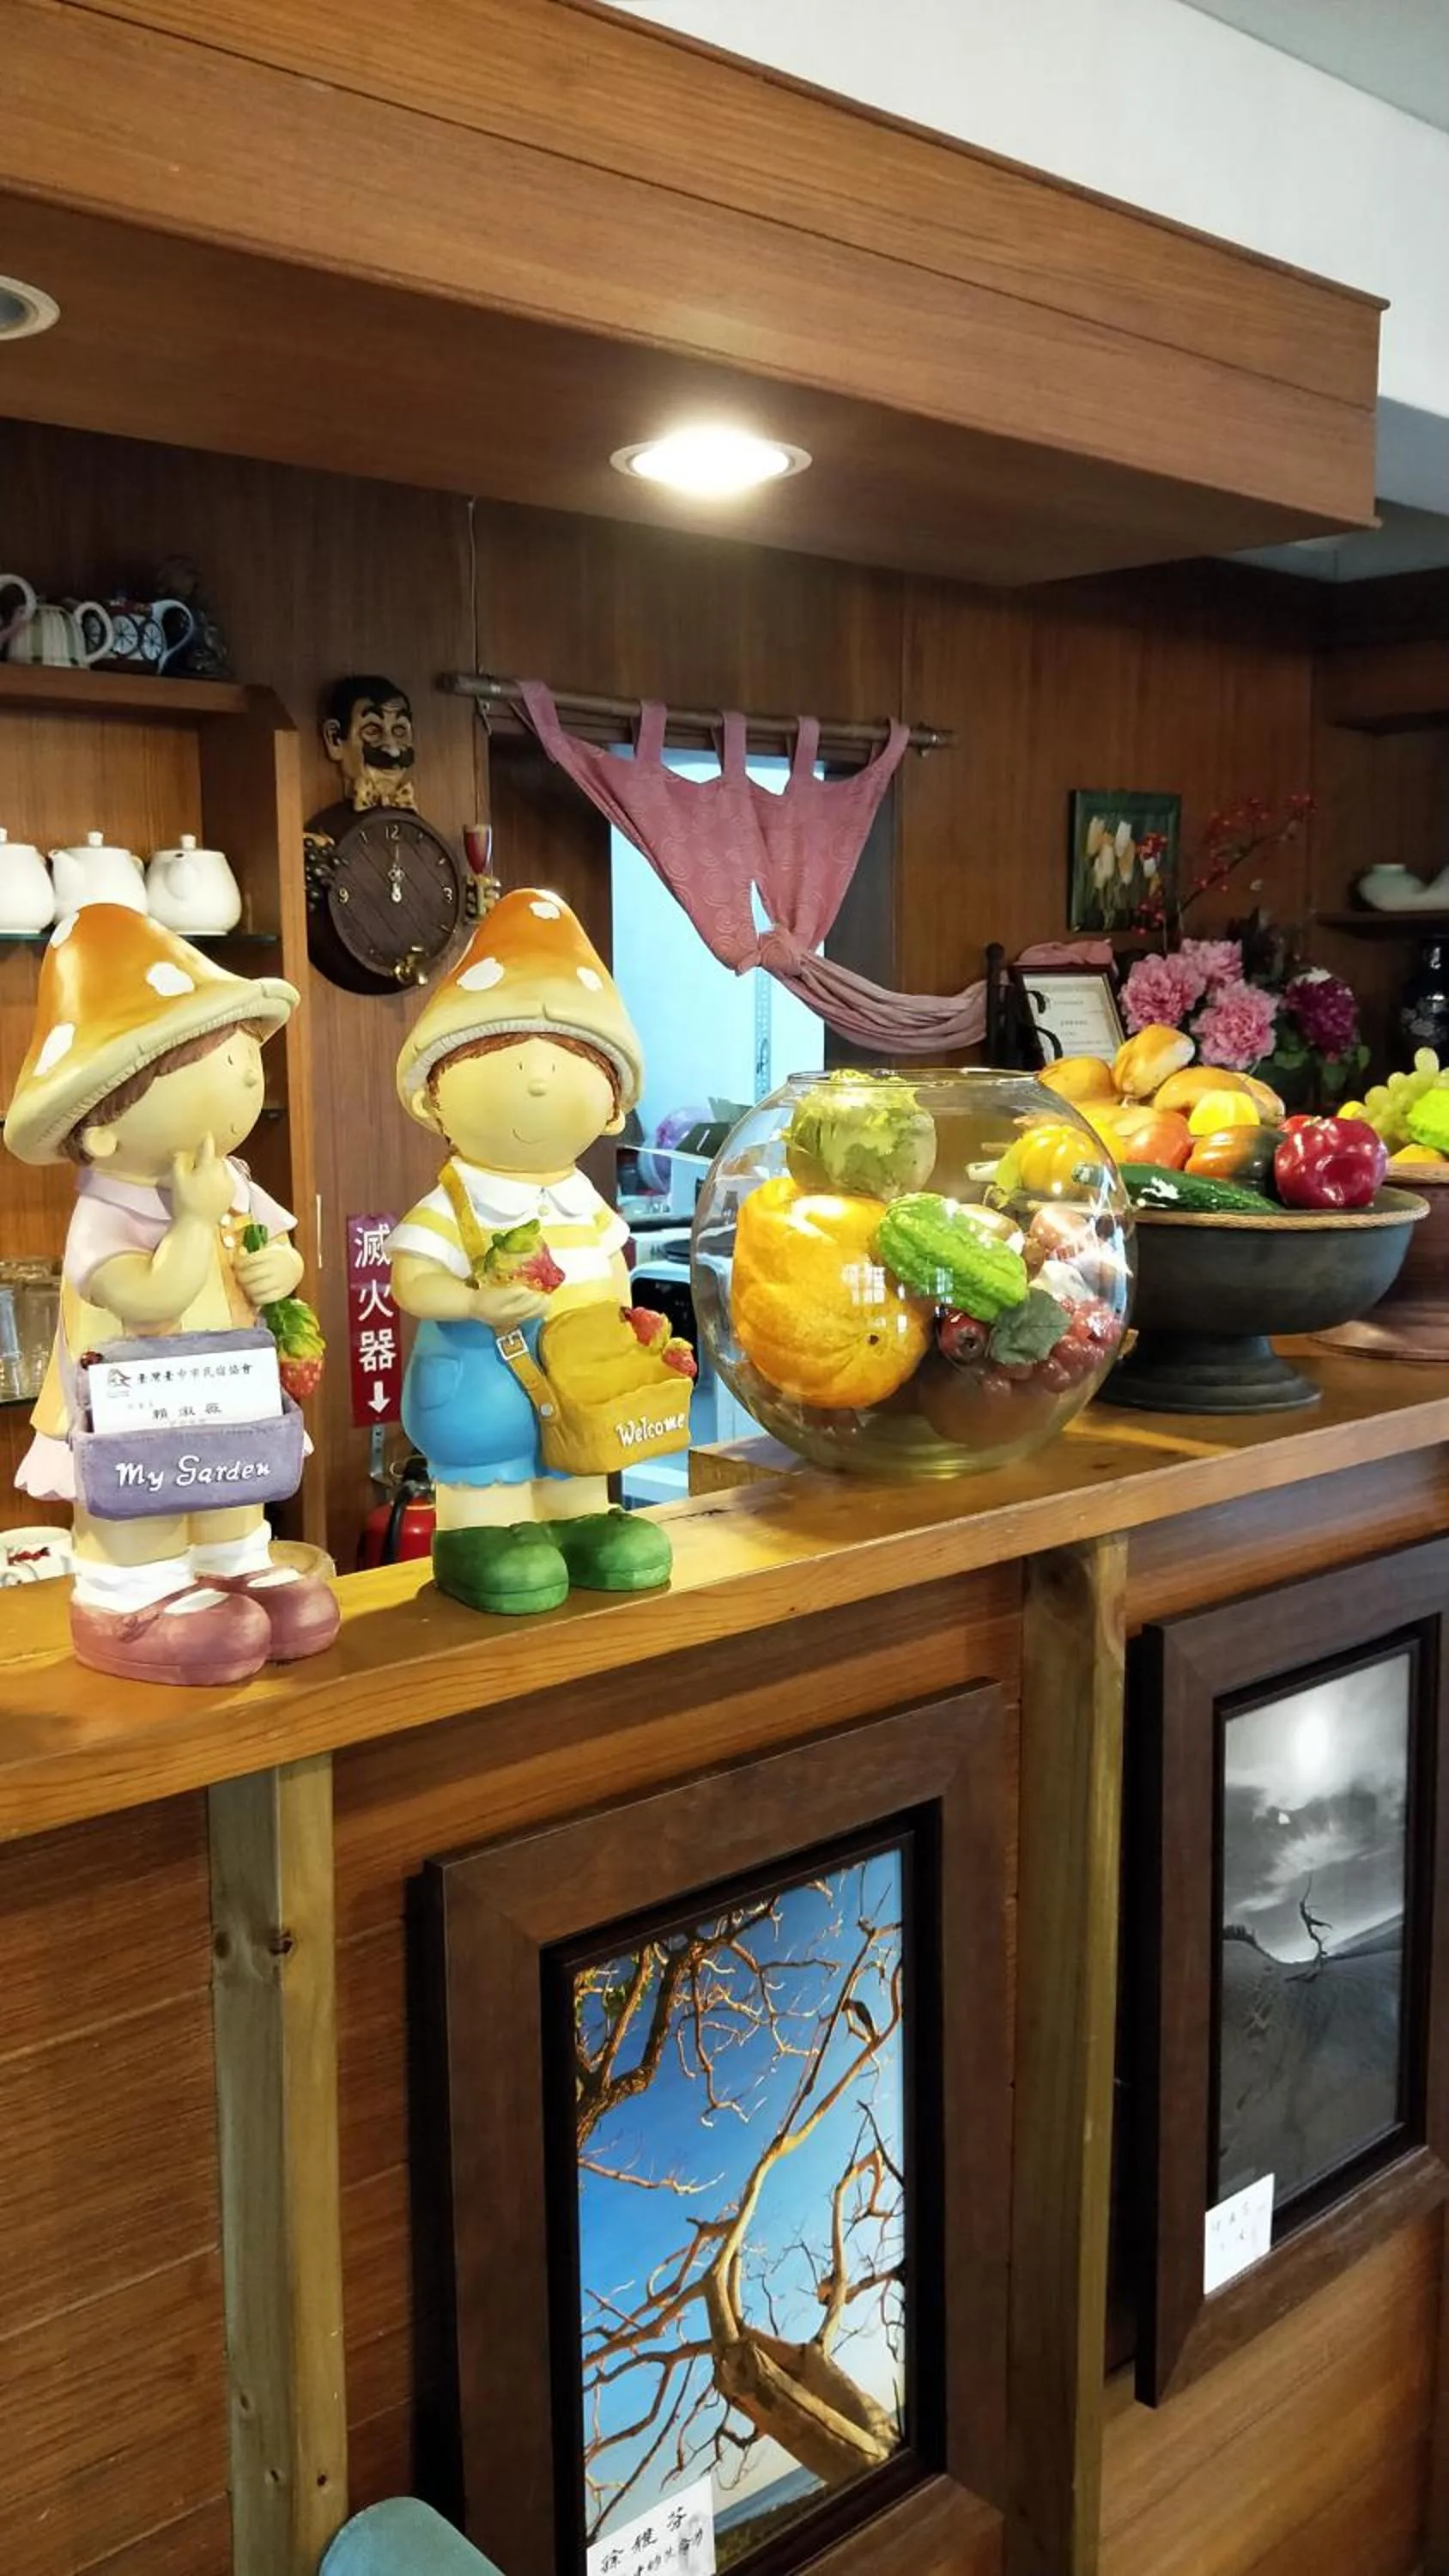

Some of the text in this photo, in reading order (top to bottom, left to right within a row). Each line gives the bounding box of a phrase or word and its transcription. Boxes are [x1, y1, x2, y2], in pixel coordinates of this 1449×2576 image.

[354, 1223, 397, 1373] 滅火器
[615, 1413, 686, 1448] Welcome
[115, 1454, 271, 1492] My Garden
